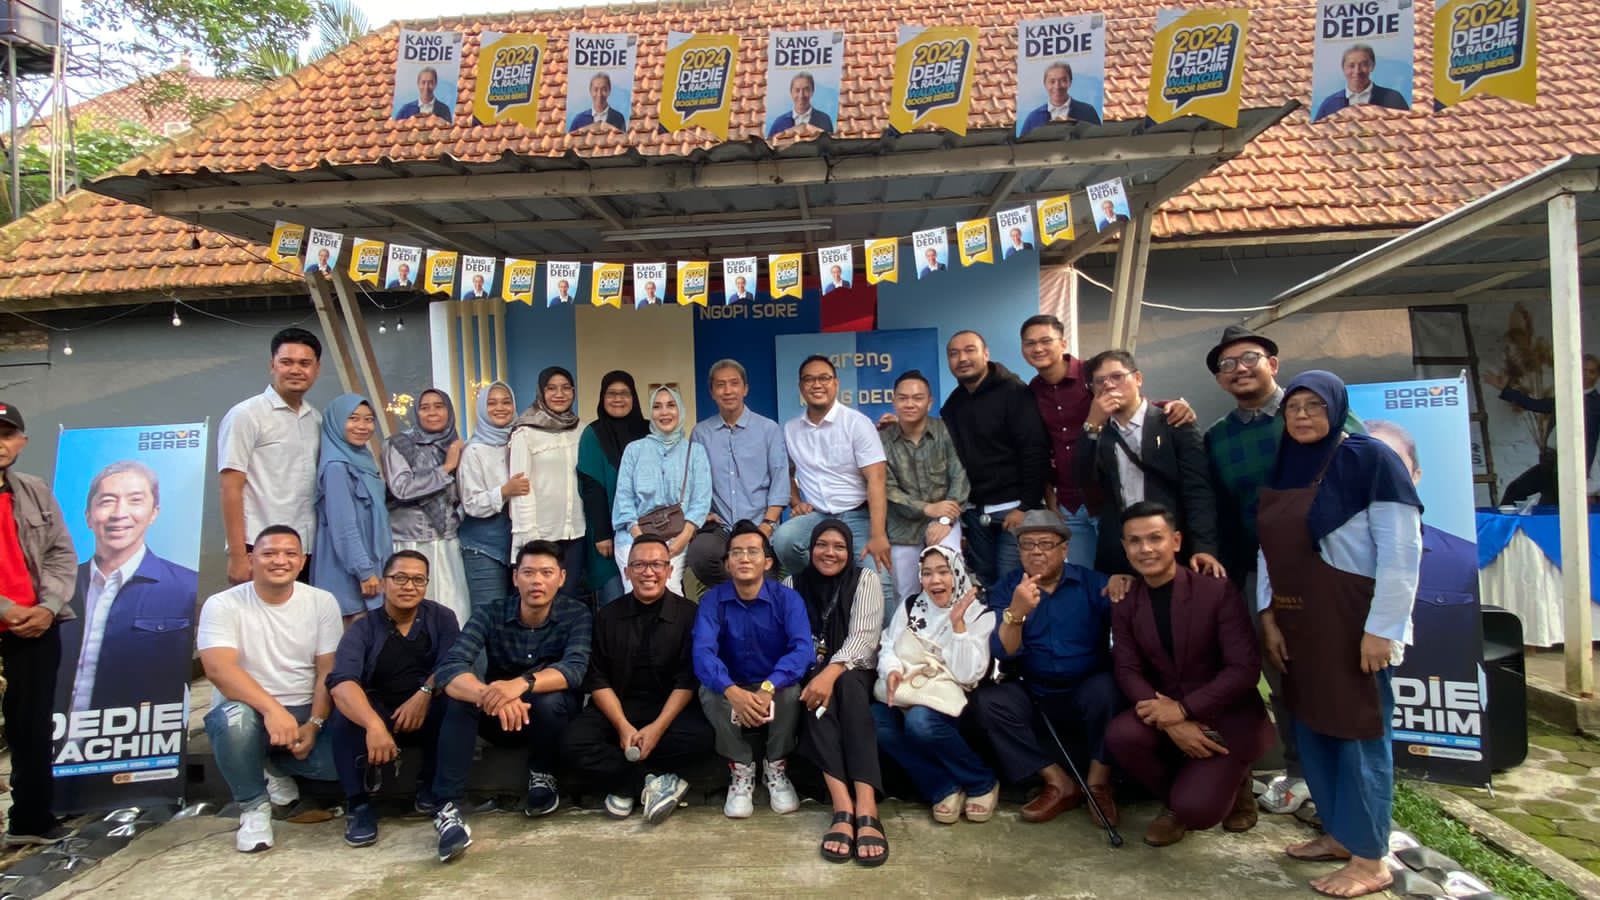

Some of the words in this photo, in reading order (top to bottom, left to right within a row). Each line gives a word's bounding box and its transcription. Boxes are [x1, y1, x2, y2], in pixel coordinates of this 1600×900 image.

[1323, 0, 1379, 19] KANG
[1453, 0, 1521, 30] 2024
[1025, 22, 1076, 38] KANG
[1322, 13, 1400, 39] DEDIE
[1452, 19, 1519, 47] DEDIE
[405, 34, 442, 46] KANG
[575, 38, 615, 50] KANG
[775, 36, 819, 49] KANG
[1025, 33, 1092, 58] DEDIE
[1175, 28, 1231, 51] 2024
[1466, 34, 1517, 56] RACHIM
[404, 46, 453, 61] DEDIE
[497, 48, 536, 65] 2024
[575, 50, 627, 66] DEDIE
[682, 50, 726, 69] 2024
[775, 48, 832, 66] DEDIE
[915, 41, 965, 65] 2024
[1170, 47, 1230, 69] DEDIE
[1451, 46, 1514, 67] WALIKOTA
[493, 64, 533, 80] DEDIE
[680, 68, 723, 84] DEDIE
[911, 60, 961, 81] DEDIE
[1182, 61, 1228, 76] RACHIM
[691, 80, 722, 90] RACHIM
[922, 74, 960, 87] RACHIM
[1167, 72, 1224, 87] WALIKOTA
[1091, 187, 1118, 200] DEDIE
[1000, 215, 1027, 227] DEDIE
[312, 237, 338, 248] DEDIE
[916, 237, 942, 247] DEDIE
[391, 253, 417, 262] DEDIE
[822, 254, 848, 264] DEDIE
[466, 264, 491, 273] DEDIE
[550, 269, 576, 278] DEDIE
[637, 271, 663, 280] DEDIE
[727, 265, 753, 274] DEDIE
[699, 305, 748, 320] NGOPI
[752, 303, 799, 318] SORE
[815, 352, 893, 373] areng
[859, 389, 894, 405] DED
[1385, 386, 1458, 399] BOGOR
[1385, 397, 1459, 410] BERES
[139, 430, 200, 440] BOGOR
[138, 440, 200, 451] BERES
[1390, 676, 1480, 710] DIE
[1392, 706, 1481, 735] HIM
[52, 731, 182, 764] ACHIM
